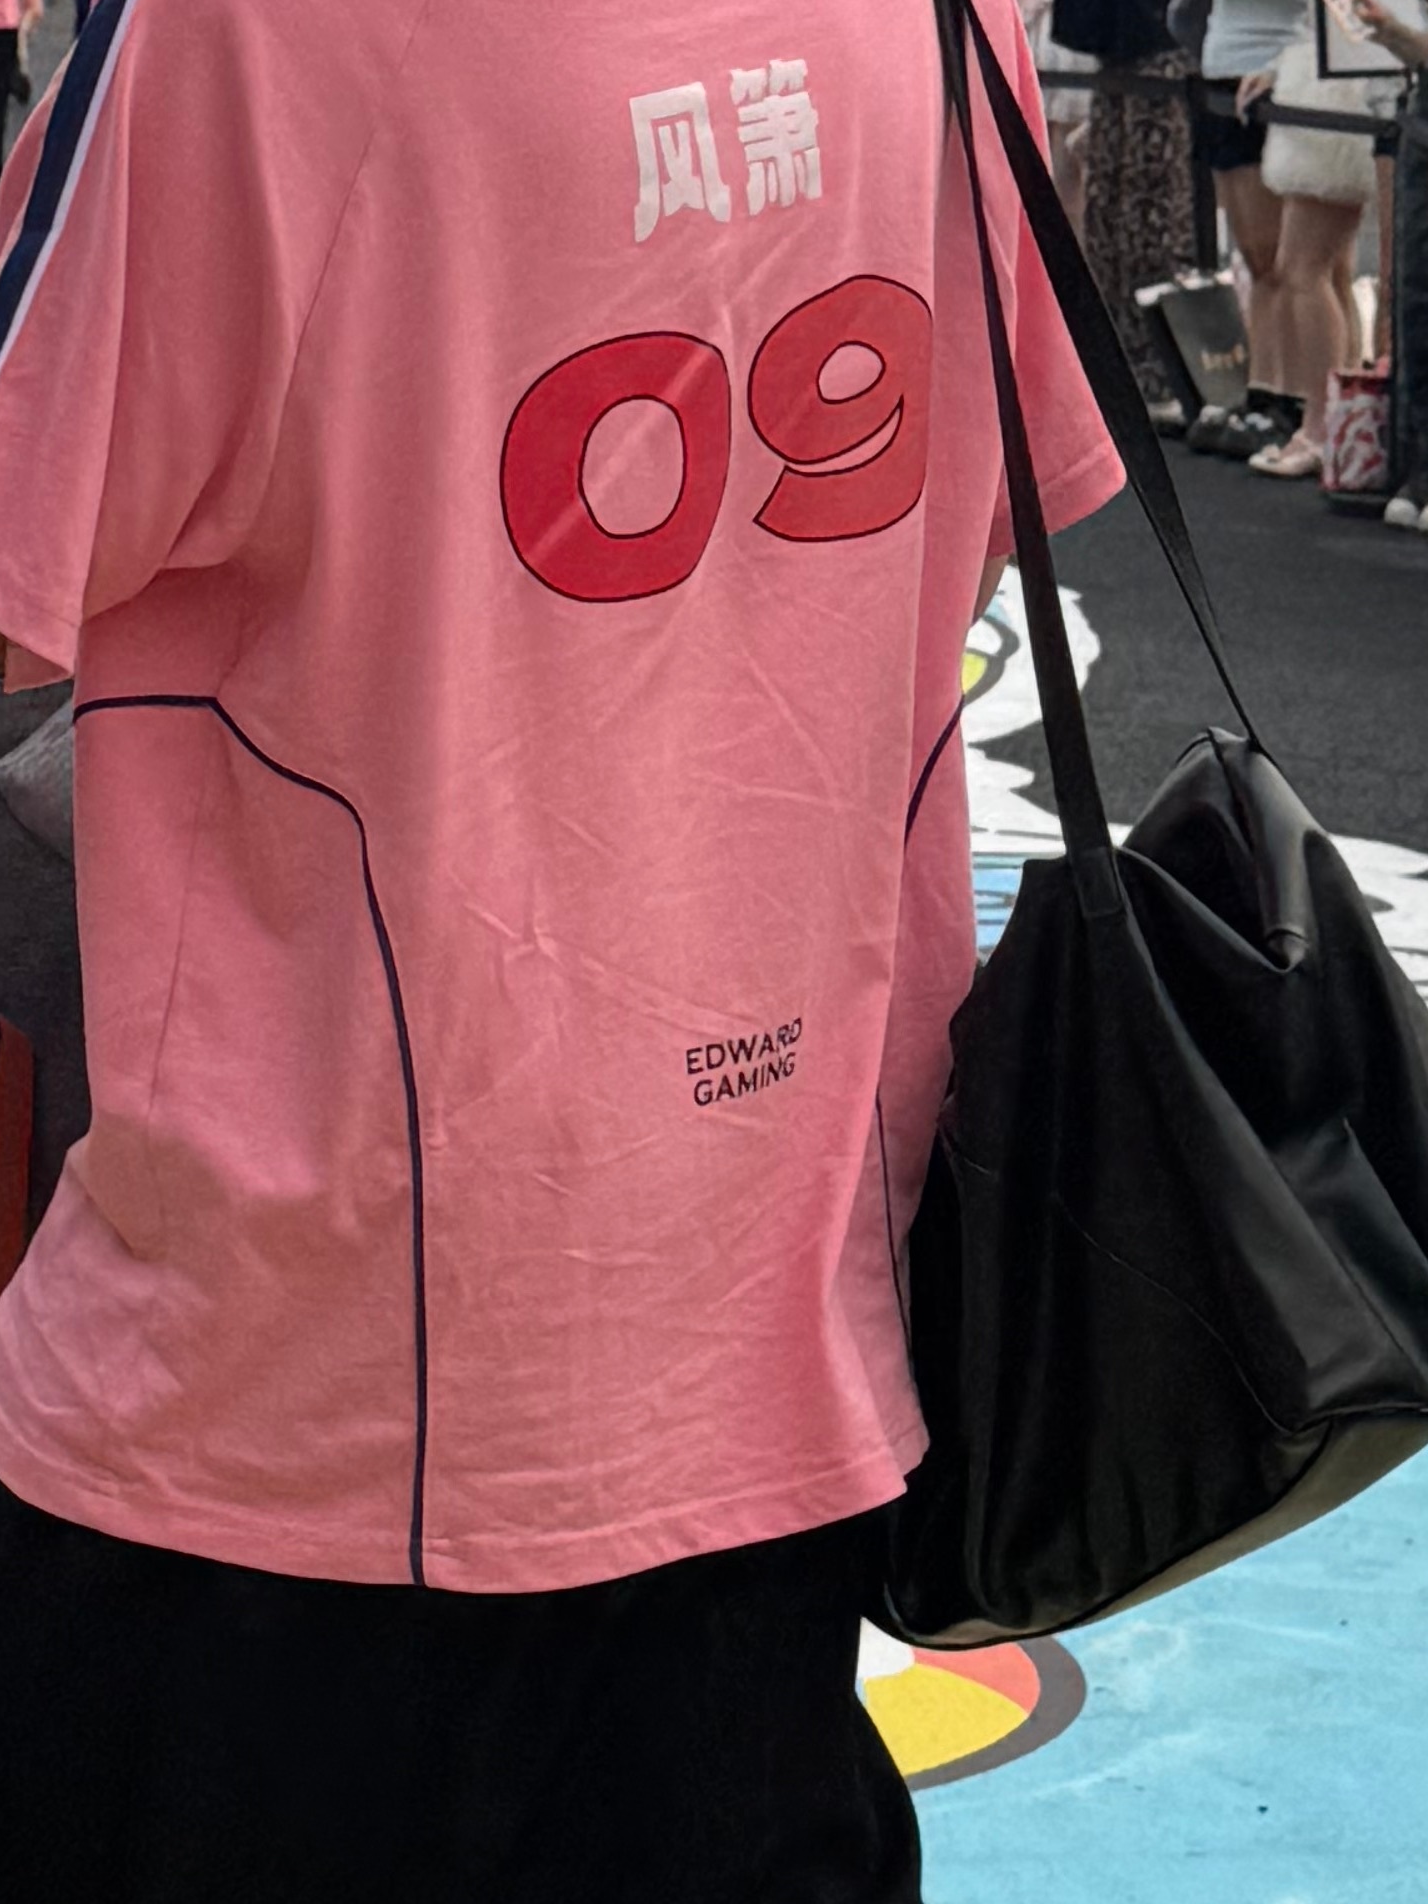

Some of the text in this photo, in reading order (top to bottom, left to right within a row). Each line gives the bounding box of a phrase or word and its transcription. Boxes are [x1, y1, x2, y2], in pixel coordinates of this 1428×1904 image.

[629, 58, 823, 243] 风箫
[499, 274, 933, 603] 09
[686, 1017, 803, 1075] EDWARD
[693, 1052, 796, 1106] GAMING
